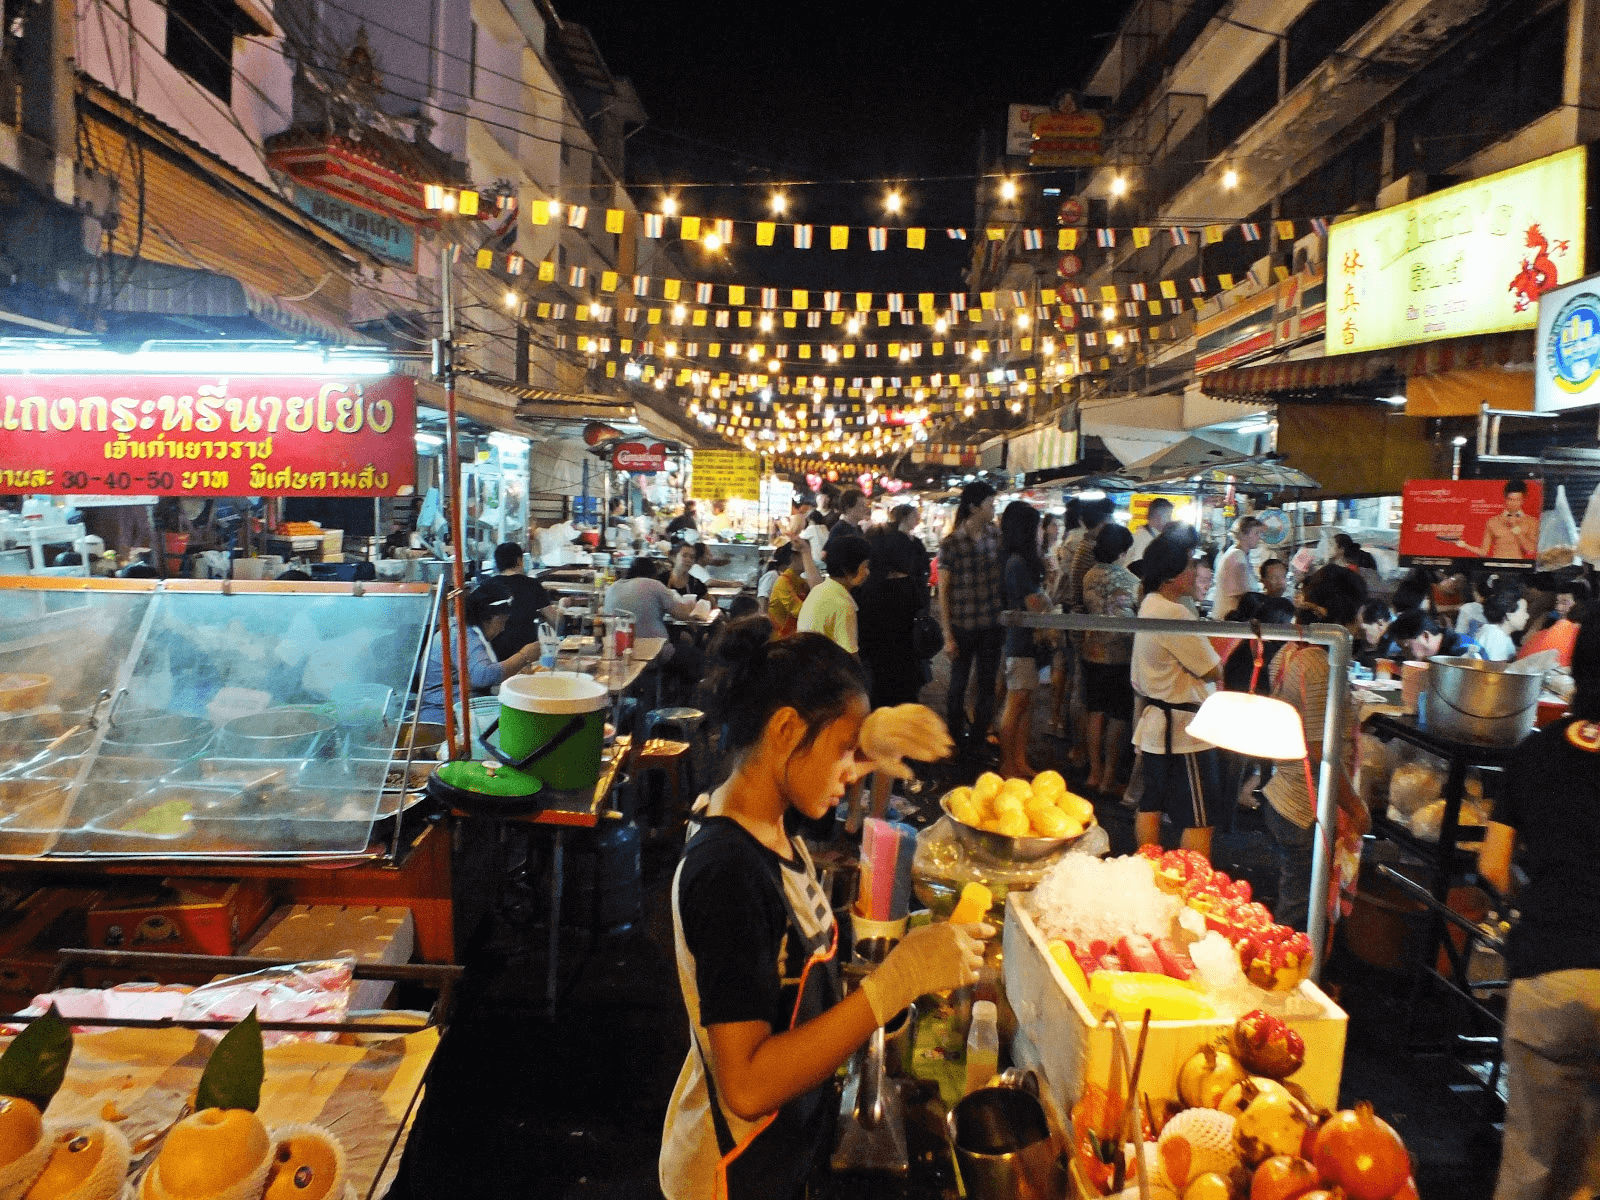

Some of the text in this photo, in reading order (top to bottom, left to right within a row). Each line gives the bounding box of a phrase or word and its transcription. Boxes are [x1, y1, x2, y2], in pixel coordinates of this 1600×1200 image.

[0, 462, 390, 490] านละ 30-40-50 บาท พิเศษตามสั่ง
